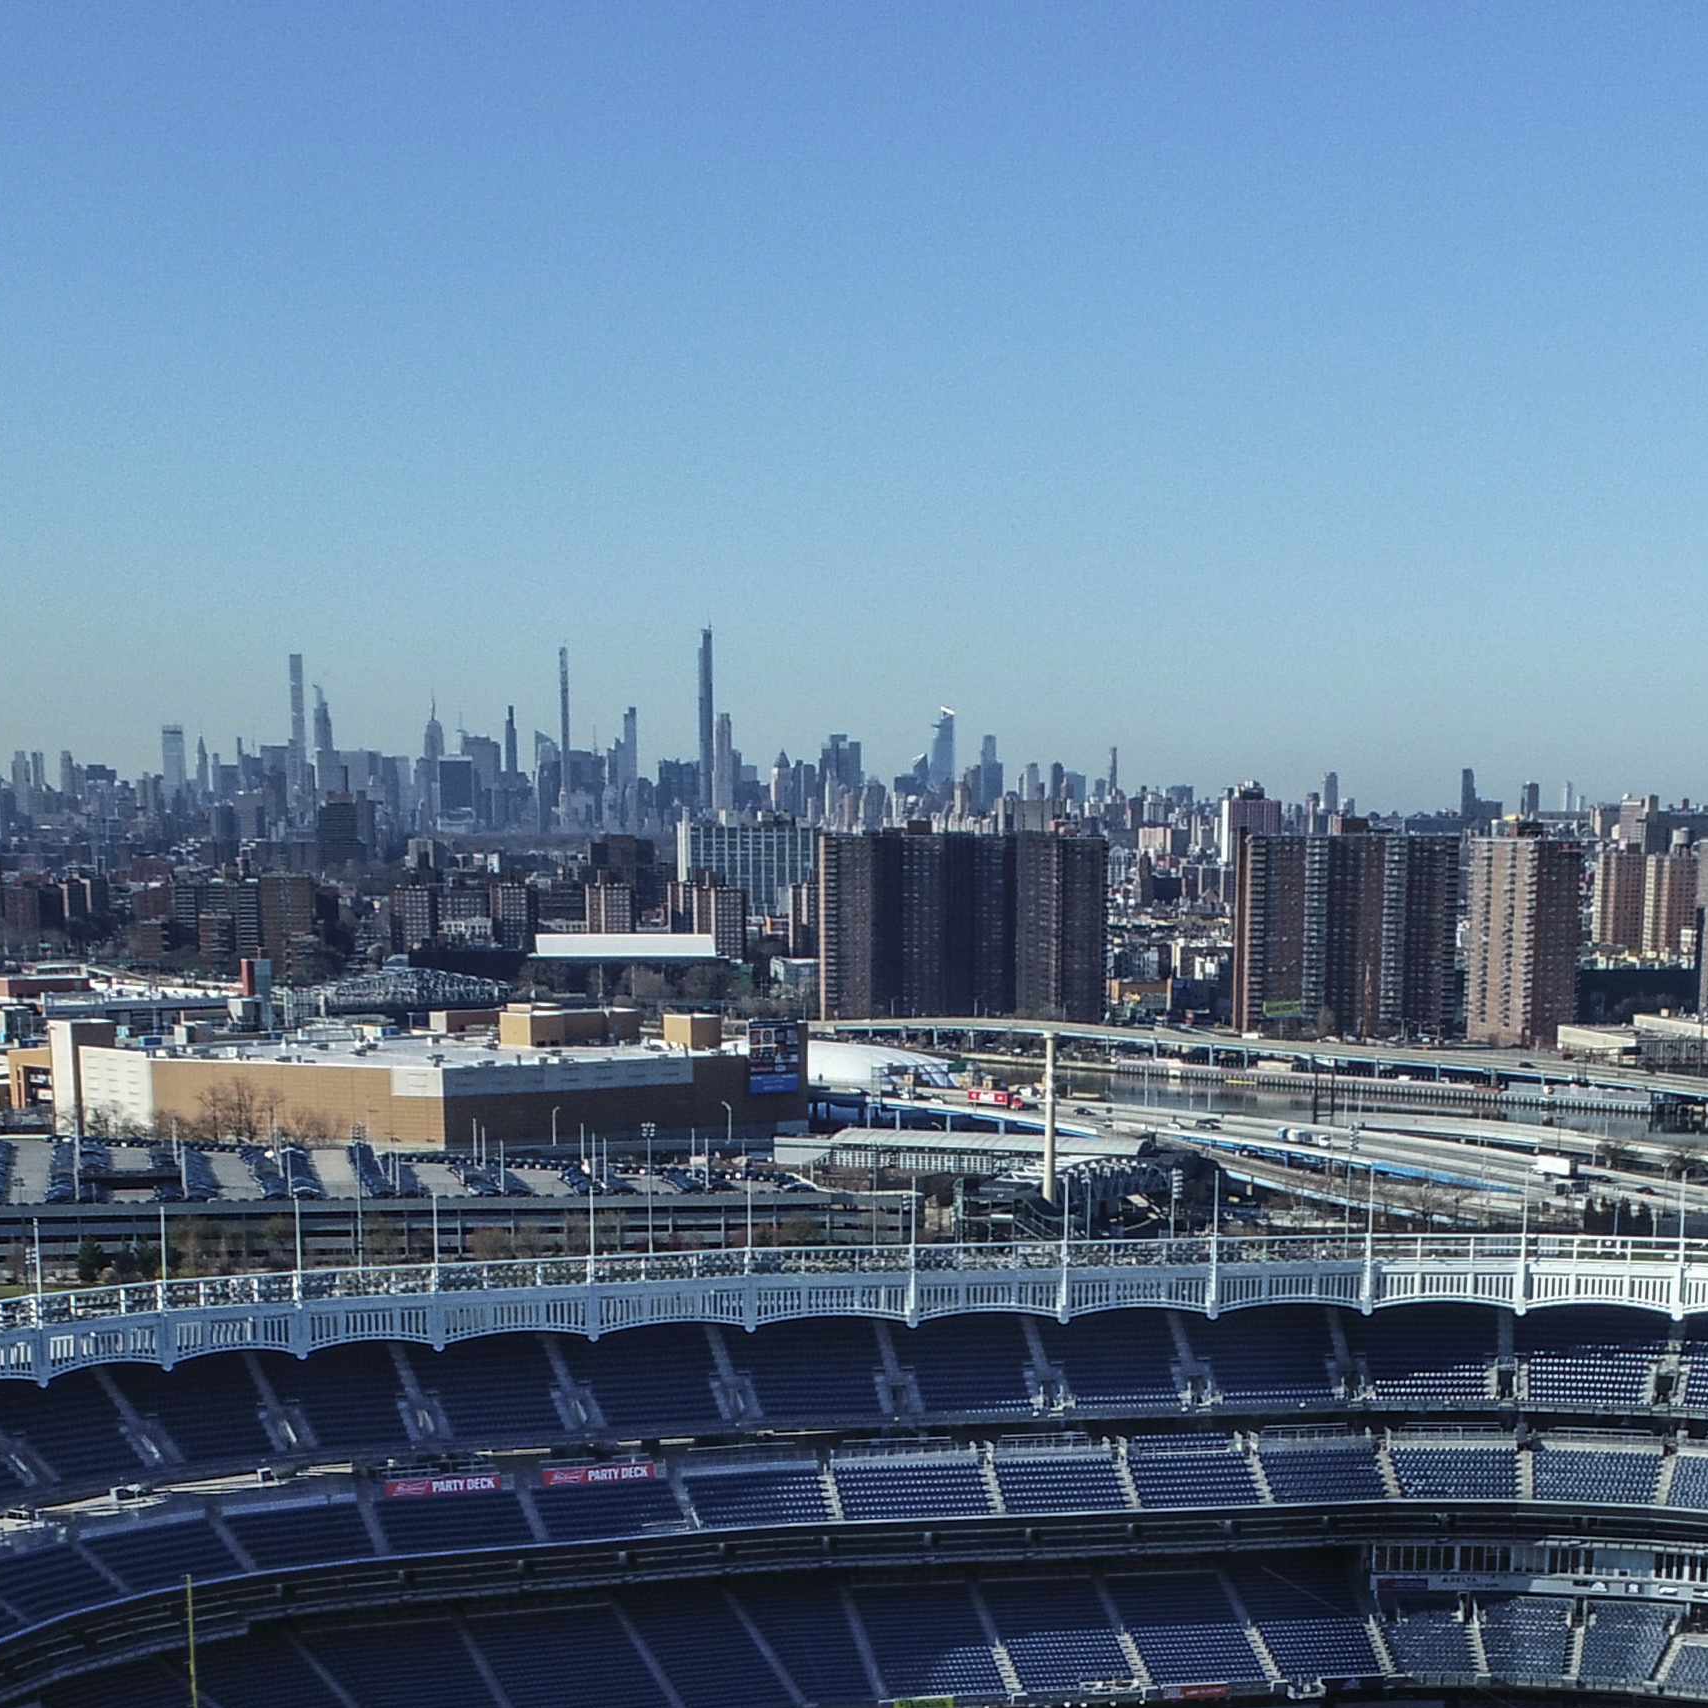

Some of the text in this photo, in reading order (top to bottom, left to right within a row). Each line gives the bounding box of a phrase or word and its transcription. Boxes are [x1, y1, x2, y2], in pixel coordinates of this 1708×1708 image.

[588, 1467, 619, 1481] PARTY
[621, 1465, 648, 1479] DECK
[432, 1479, 464, 1492] PARTY
[466, 1477, 496, 1490] DECK
